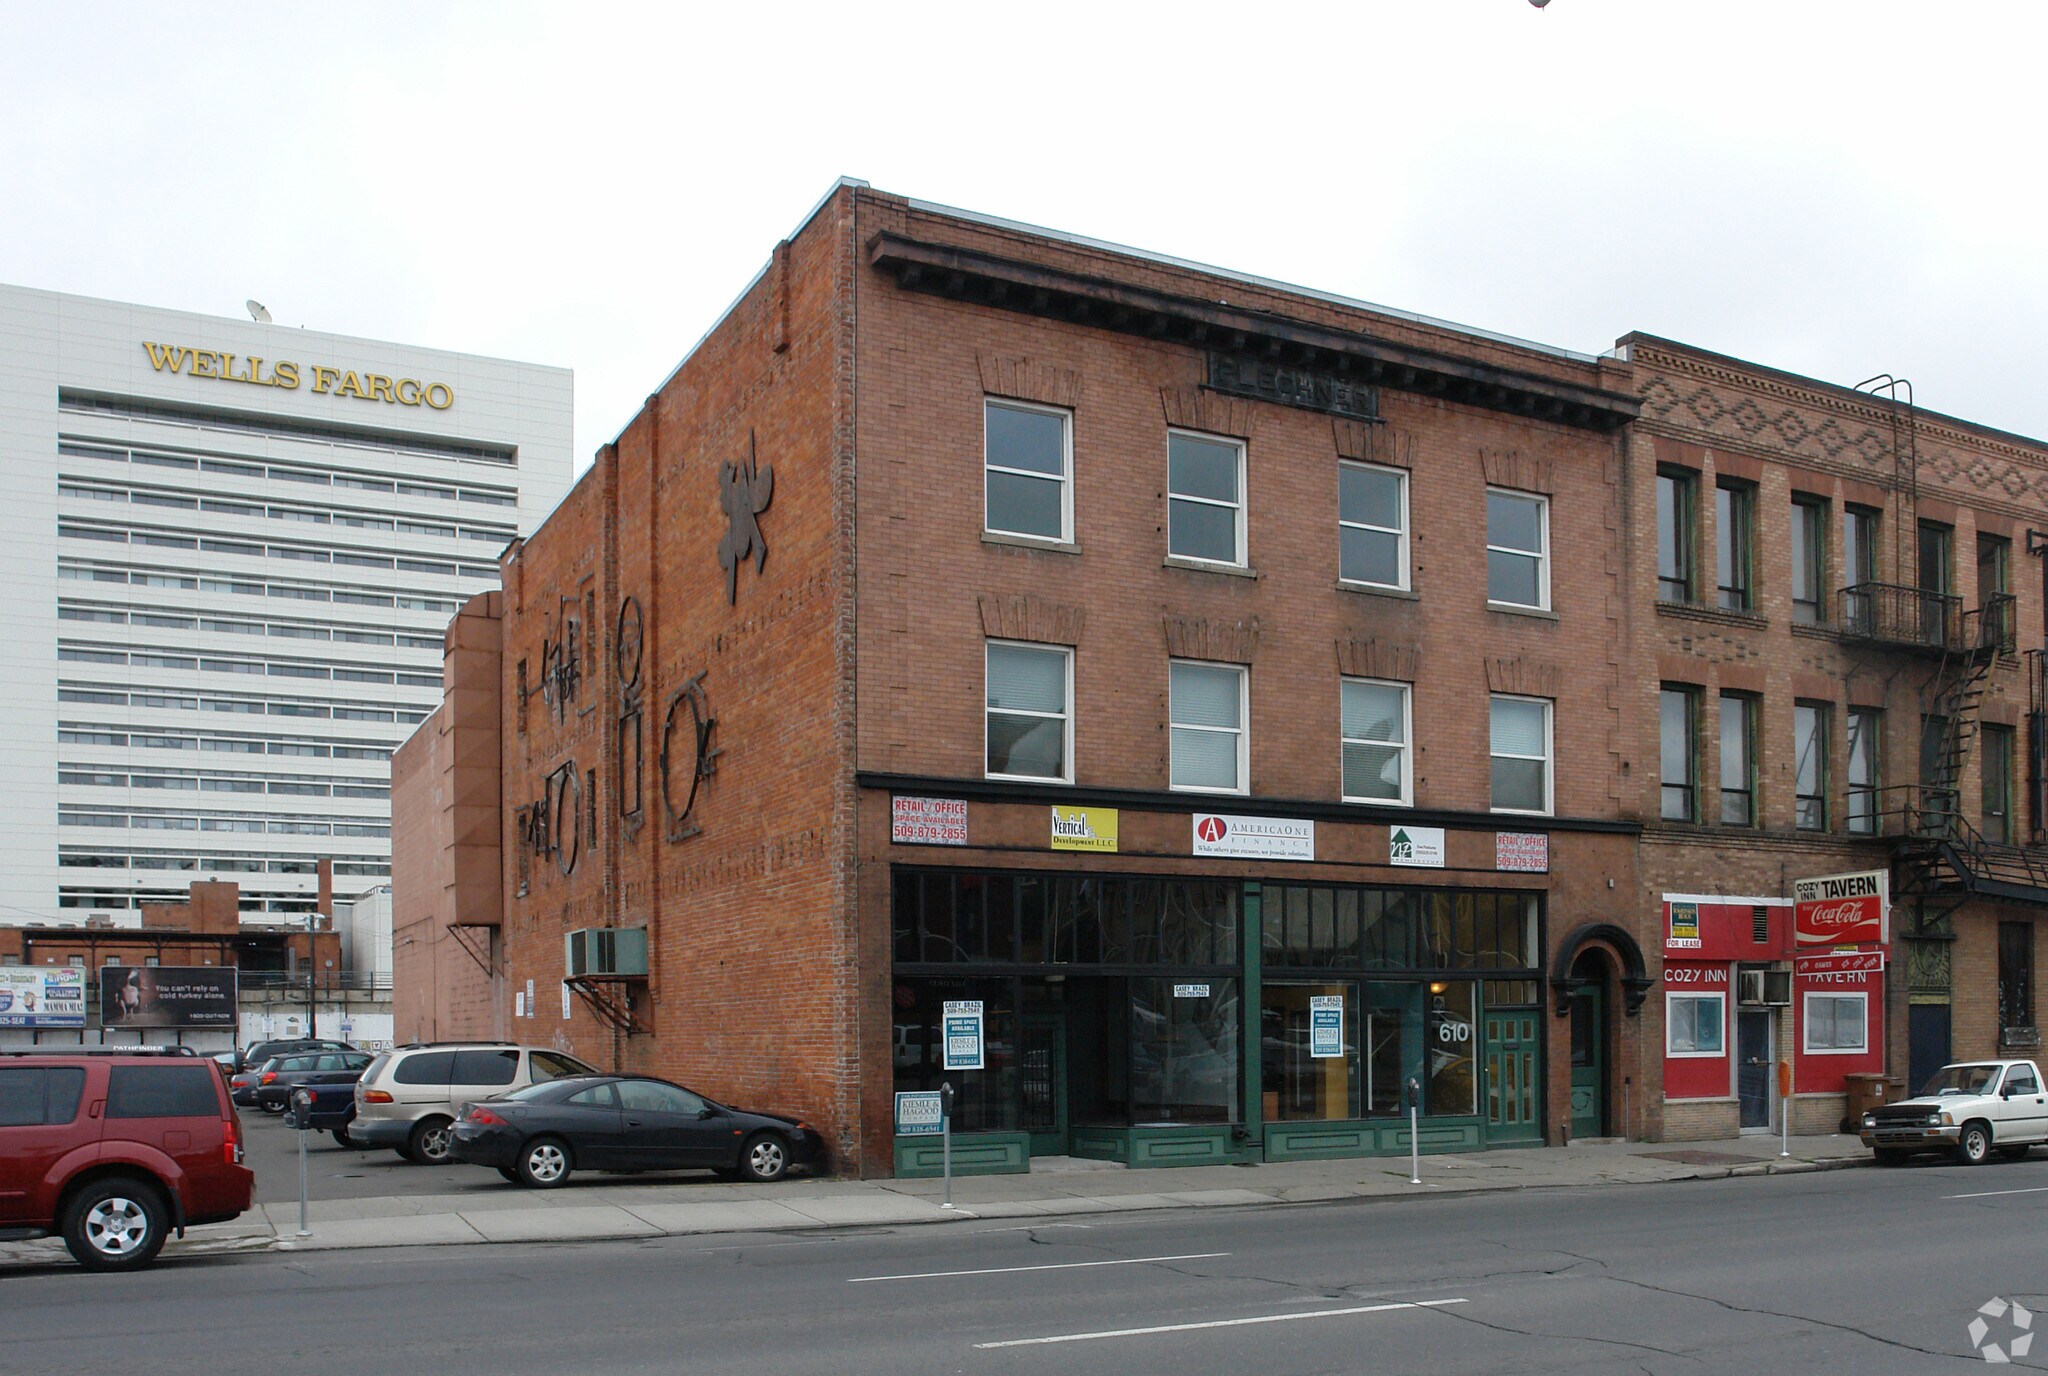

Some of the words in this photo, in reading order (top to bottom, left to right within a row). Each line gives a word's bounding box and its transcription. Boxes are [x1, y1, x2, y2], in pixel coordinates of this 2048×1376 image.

[142, 341, 300, 389] WELLS
[311, 365, 454, 410] FARGO
[895, 800, 925, 812] RETAIL
[935, 802, 965, 815] OFFICE
[895, 814, 920, 823] SPACE
[923, 816, 965, 825] AVAILABLE
[894, 825, 966, 839] 509-879-2855
[1231, 837, 1309, 848] FINANCE
[1498, 835, 1518, 846] RETAIL
[1525, 836, 1546, 847] OFFICE
[1497, 856, 1547, 868] 509-879-2855
[1796, 881, 1820, 892] COZY
[1821, 876, 1877, 898] TAVERN
[1800, 891, 1816, 901] INN
[1667, 939, 1679, 947] FOR
[1682, 940, 1700, 948] LEASE
[1664, 969, 1702, 982] COZY
[1704, 969, 1727, 982] INN
[193, 985, 208, 993] rely
[1440, 1023, 1469, 1041] 610
[902, 1100, 931, 1108] KIEMLE
[932, 1100, 940, 1108] &
[903, 1107, 939, 1115] HAGOOD
